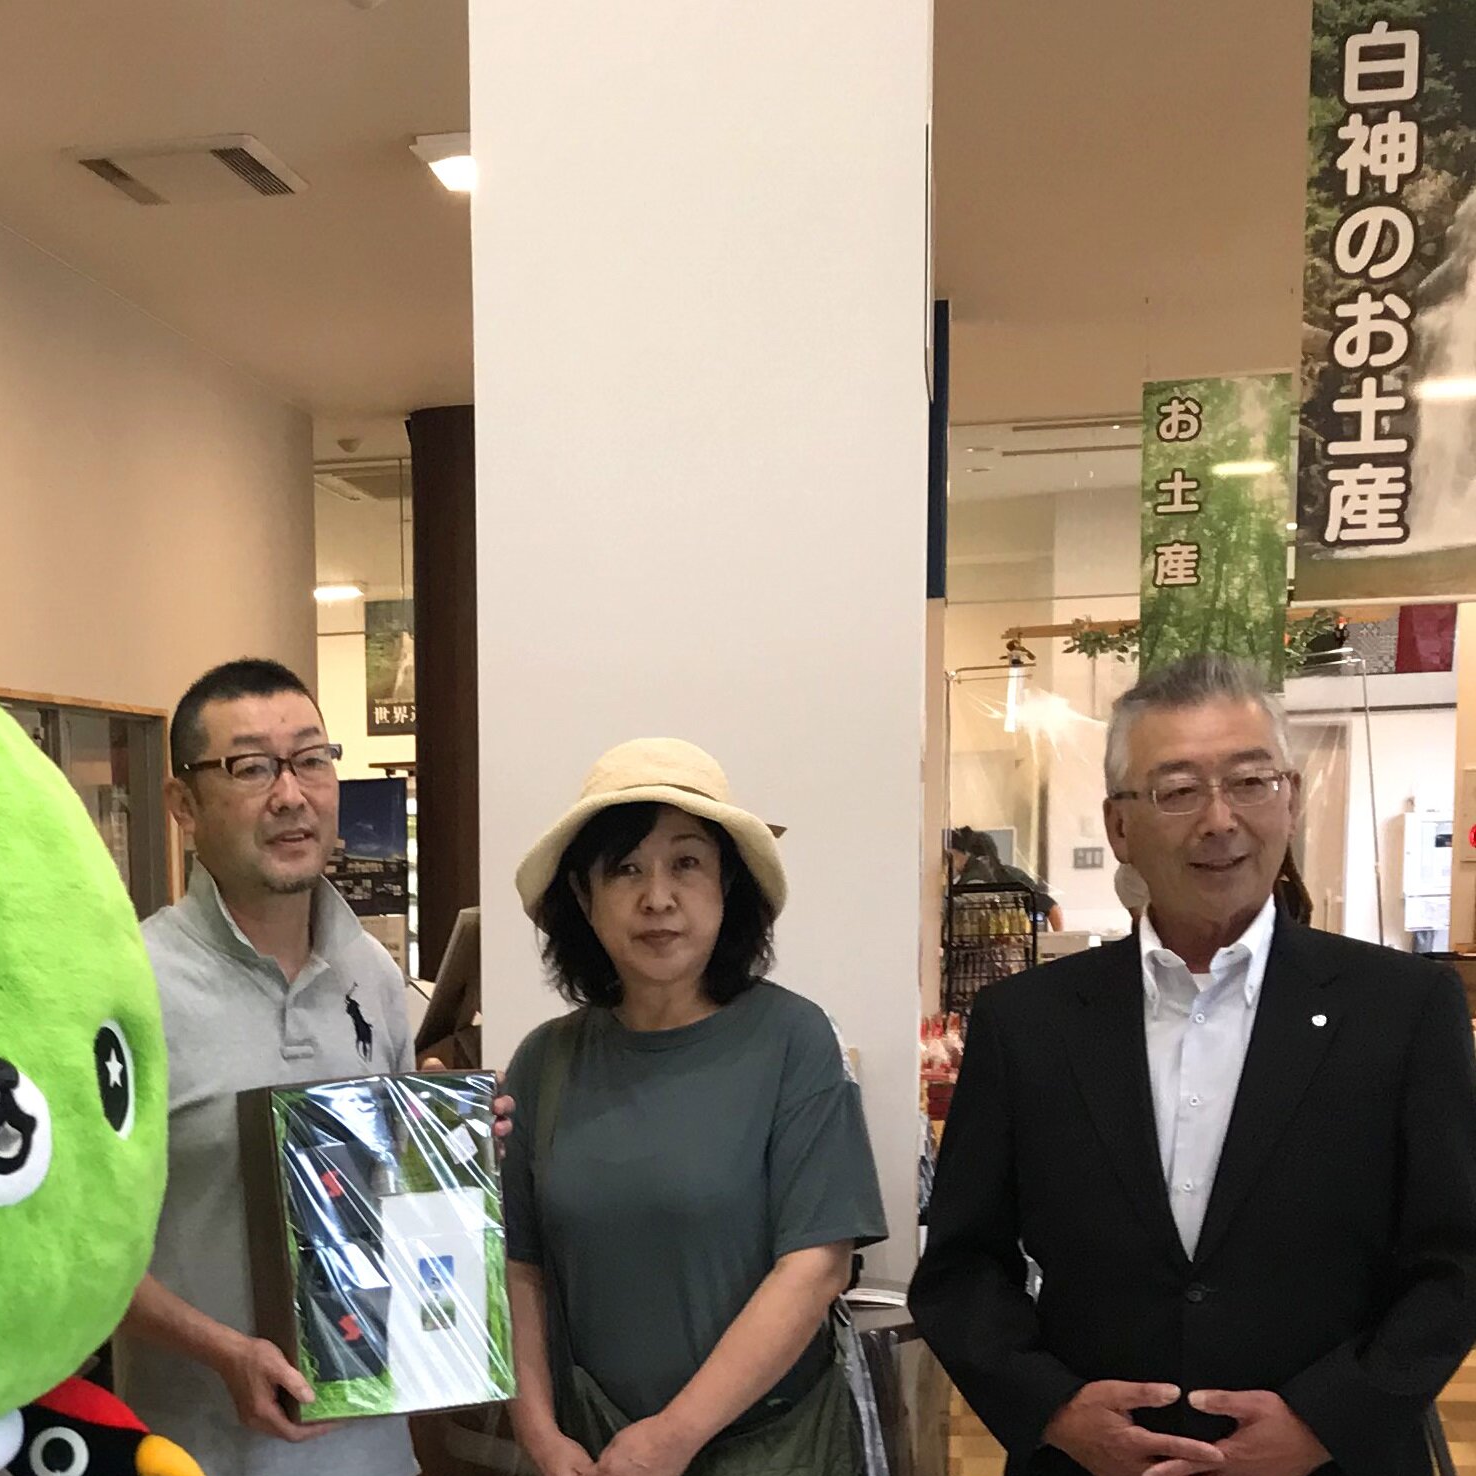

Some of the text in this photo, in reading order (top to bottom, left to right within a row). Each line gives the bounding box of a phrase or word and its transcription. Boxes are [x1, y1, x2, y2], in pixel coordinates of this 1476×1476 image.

[1323, 20, 1421, 544] 白神のお土産
[1153, 396, 1203, 587] お土産
